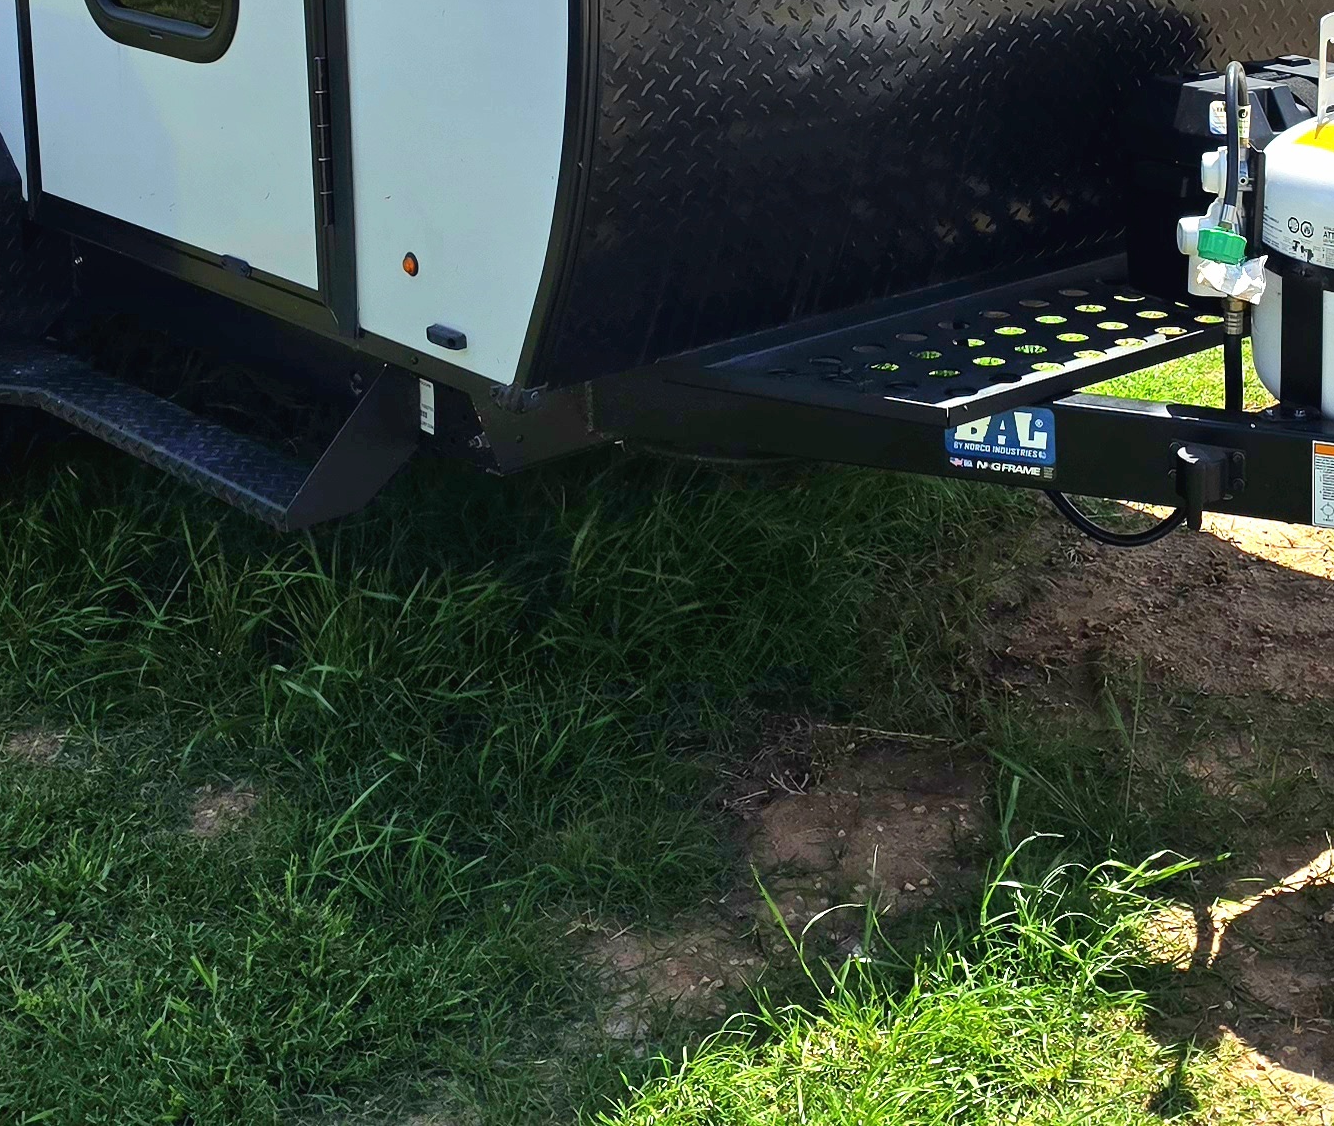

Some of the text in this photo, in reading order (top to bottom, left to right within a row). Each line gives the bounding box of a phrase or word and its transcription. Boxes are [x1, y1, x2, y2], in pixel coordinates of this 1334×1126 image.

[953, 440, 1038, 459] BY NORCO INDUSTRIES
[1001, 463, 1041, 476] FRAME
